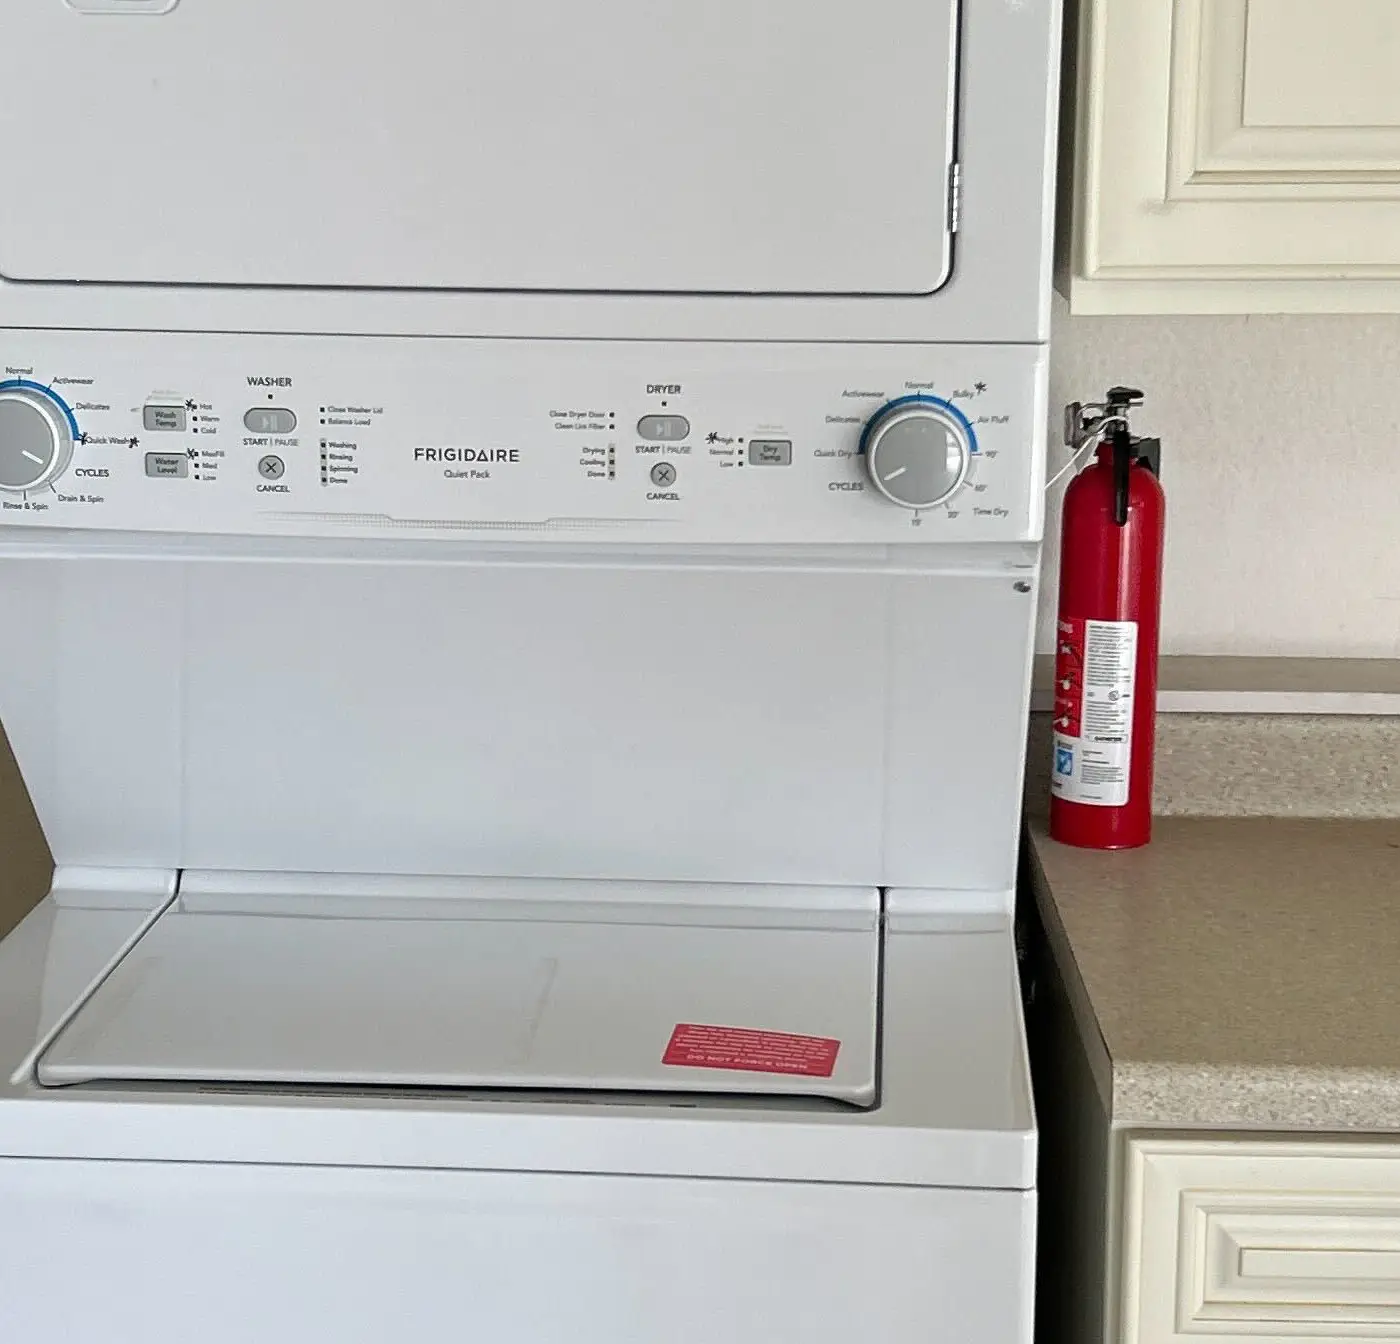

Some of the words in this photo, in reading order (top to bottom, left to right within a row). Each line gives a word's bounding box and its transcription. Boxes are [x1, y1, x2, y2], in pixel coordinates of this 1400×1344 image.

[247, 376, 292, 387] WASHER
[646, 384, 681, 395] DRYER
[243, 437, 268, 447] START
[274, 439, 298, 447] PAUSE
[413, 447, 521, 463] FRIGIDAIRE
[635, 445, 660, 454] START
[667, 446, 692, 455] PAUSE
[75, 468, 110, 478] CYCLES
[443, 469, 469, 479] Quiet
[470, 470, 491, 479] Pack
[256, 484, 290, 494] CANCEL
[828, 482, 865, 492] CYCLES
[646, 492, 681, 502] CANCEL
